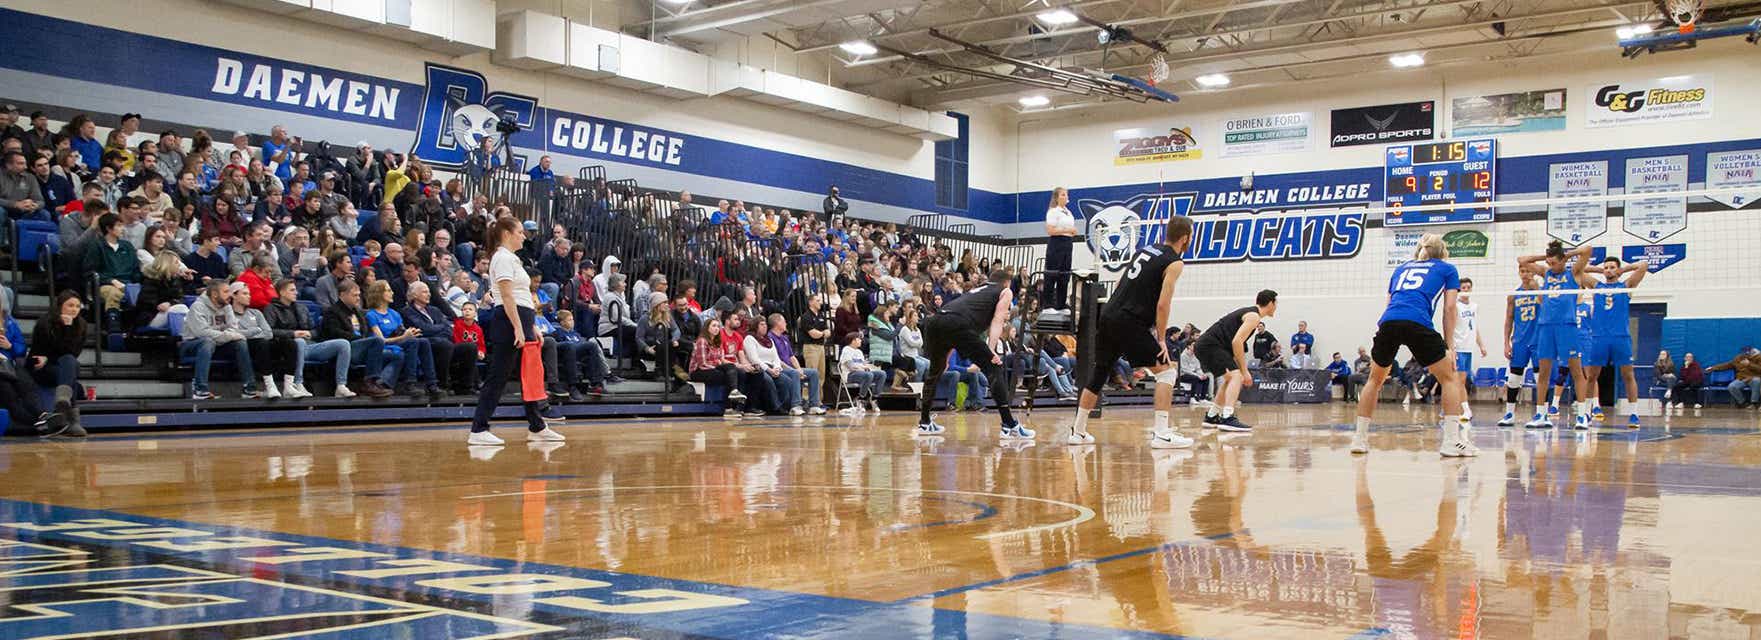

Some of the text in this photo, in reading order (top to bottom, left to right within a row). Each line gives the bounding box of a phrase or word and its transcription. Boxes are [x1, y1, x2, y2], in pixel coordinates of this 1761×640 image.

[212, 57, 401, 120] DAEMEN
[1595, 84, 1705, 113] G&G Fitness
[1226, 115, 1301, 130] O'BRIEN & FORD
[552, 117, 685, 165] COLLEGE
[1333, 128, 1432, 147] ADPRO SPORTS
[1432, 143, 1464, 160] 1:15
[1392, 167, 1414, 175] HOME
[1463, 161, 1488, 170] GUEST
[1632, 165, 1682, 175] BASKETBALL
[1713, 161, 1761, 169] VOLLEYBAL
[1474, 172, 1490, 189] 12
[1555, 170, 1602, 179] BASKETBALL
[1406, 176, 1416, 192] 9
[1434, 176, 1443, 190] 2
[1204, 184, 1371, 208] DAEMEN COLLEGE
[1127, 252, 1151, 280] 5
[1395, 268, 1429, 291] 15
[1520, 306, 1536, 321] 23
[1258, 382, 1278, 390] MAKE
[1287, 378, 1314, 393] YOURS
[0, 518, 750, 615] COLLEGE
